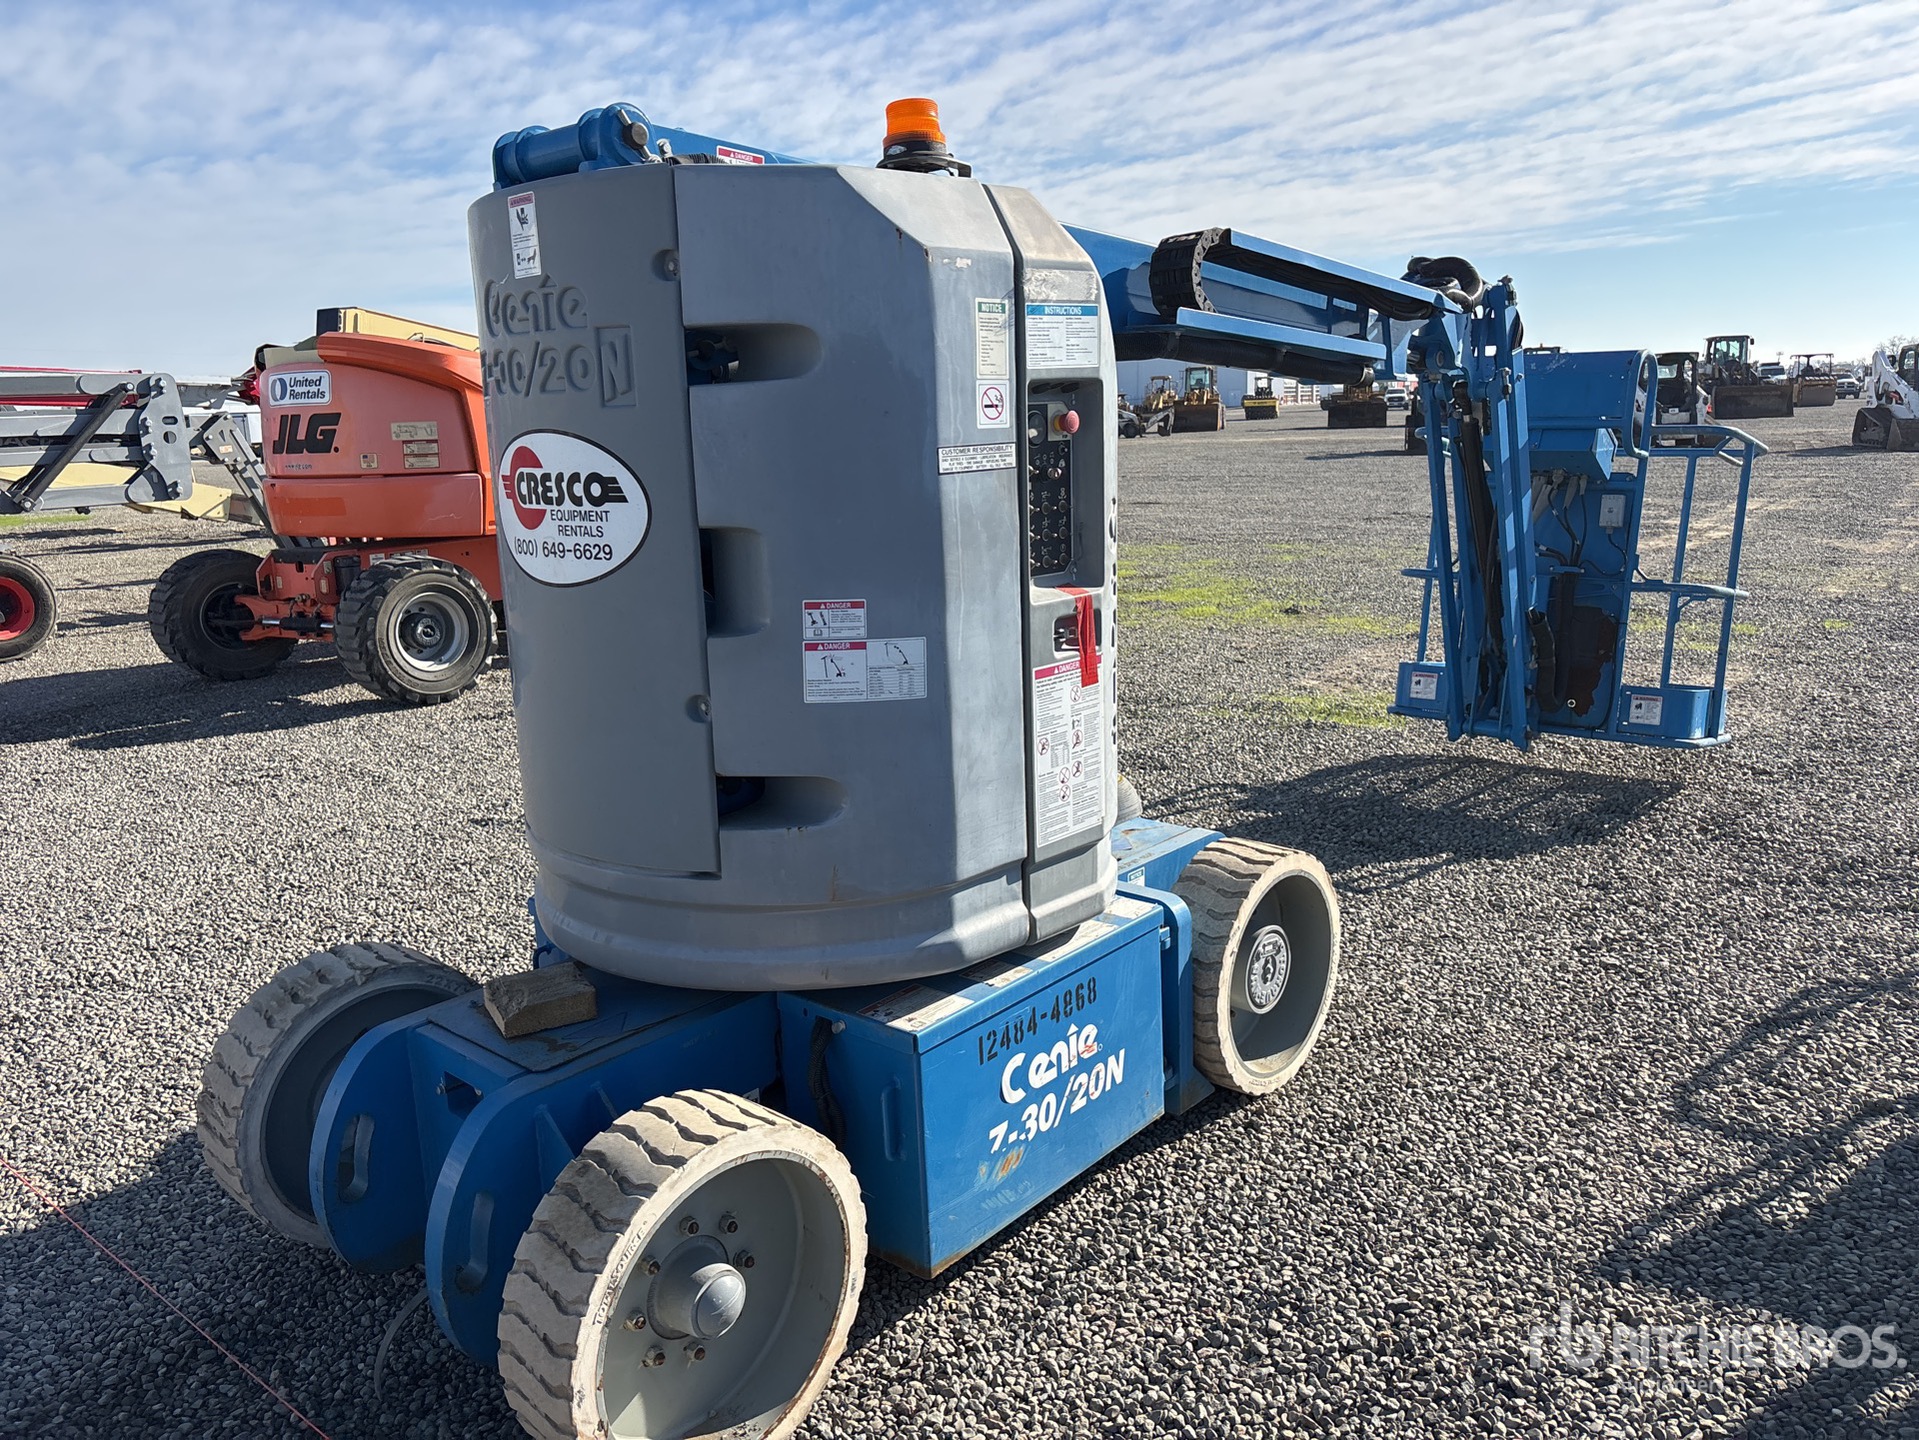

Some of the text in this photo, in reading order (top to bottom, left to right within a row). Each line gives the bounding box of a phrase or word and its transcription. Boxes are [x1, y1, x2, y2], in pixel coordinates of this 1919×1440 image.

[735, 152, 754, 162] DANGER
[981, 303, 1003, 313] NOTICE
[1044, 306, 1082, 315] INSTRUCTIONS
[289, 376, 323, 388] United
[289, 388, 326, 401] Rentals
[941, 445, 1013, 456] CUSTOMER RESPONSIBILITY
[516, 471, 629, 508] CRESCO
[550, 509, 611, 523] EQUIPMENT
[557, 525, 604, 538] RENTALS
[514, 536, 613, 561] (800) 649-6629
[824, 642, 851, 650] DANGER
[1059, 661, 1081, 673] DANGER
[978, 976, 1098, 1066] 12484-4868
[1000, 1022, 1101, 1105] Genie
